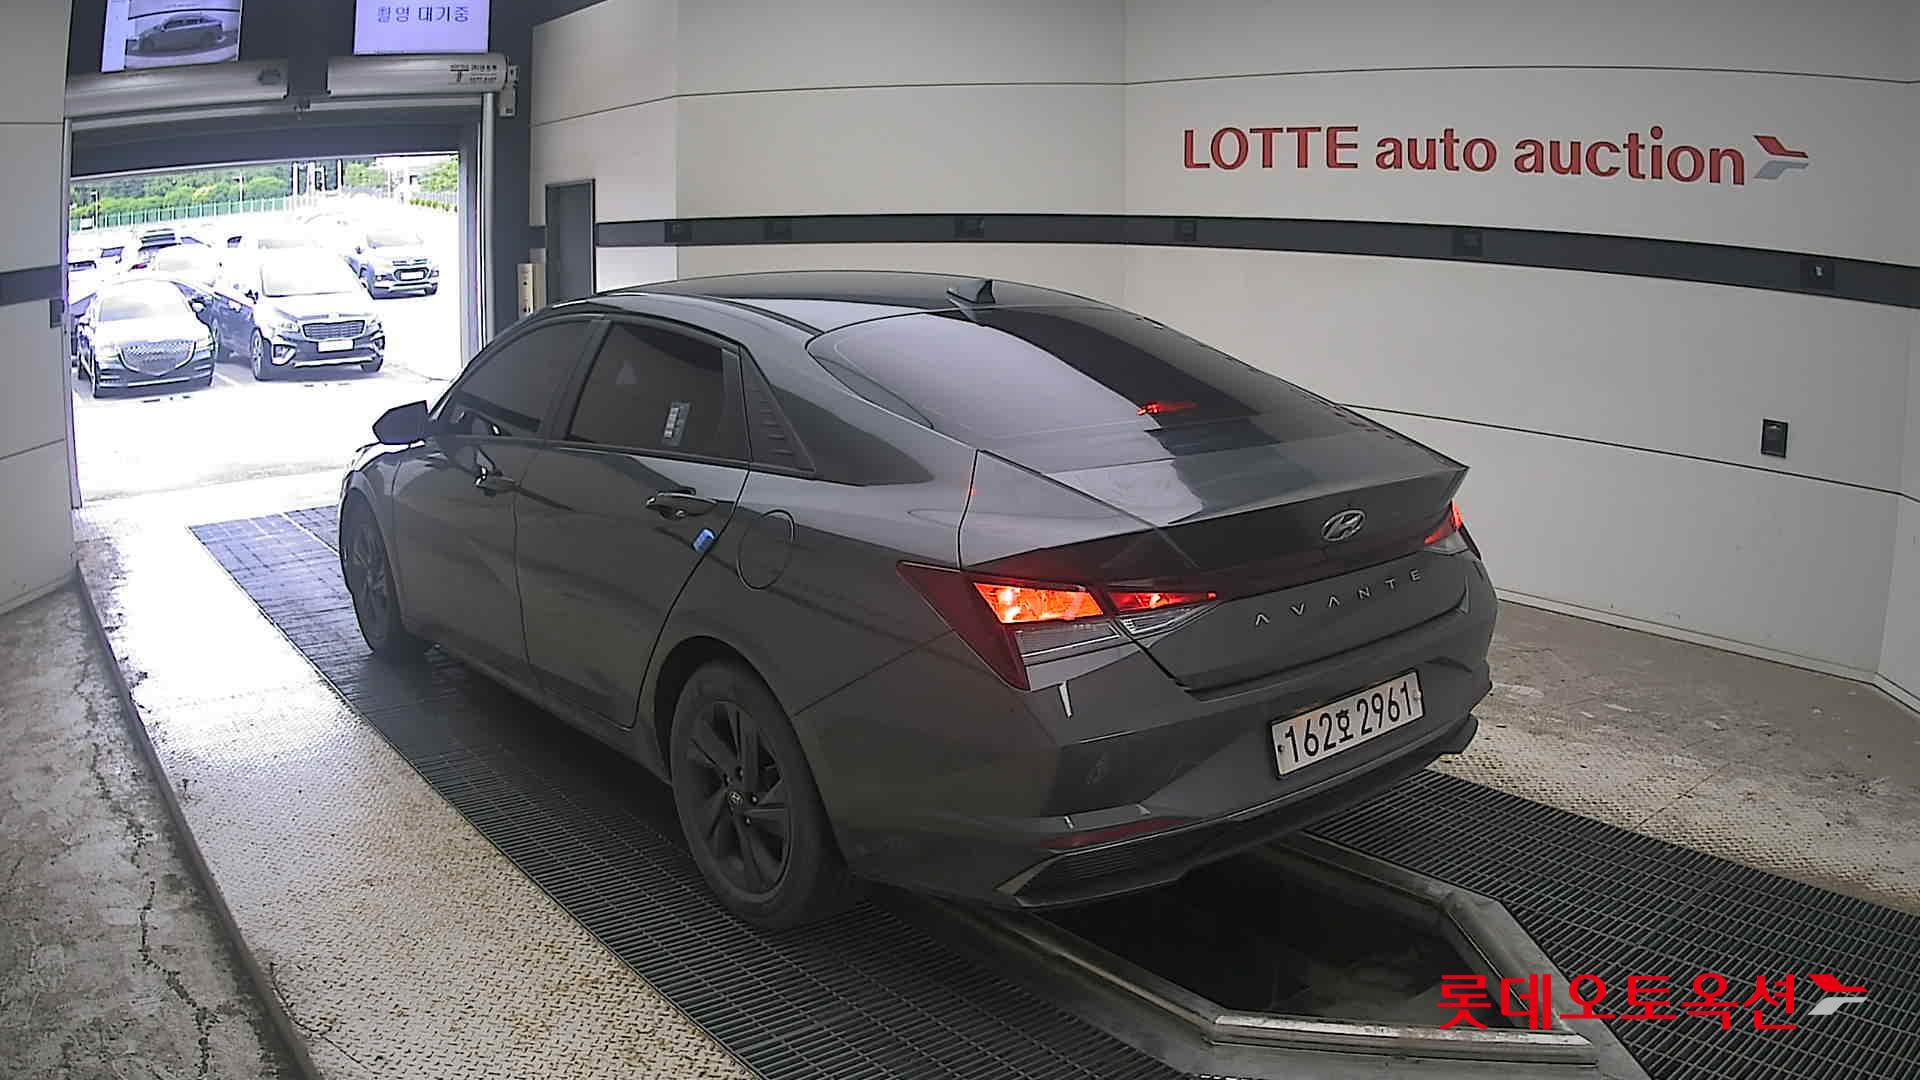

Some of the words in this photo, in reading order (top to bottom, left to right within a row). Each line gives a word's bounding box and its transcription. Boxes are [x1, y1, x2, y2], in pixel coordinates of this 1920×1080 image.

[418, 6, 469, 23] 대기중
[1183, 125, 1359, 170] LOTTE
[1375, 127, 1498, 172] auto
[1513, 126, 1745, 186] auction
[1254, 568, 1423, 628] AVANTE
[1284, 709, 1354, 763] 162호
[1356, 681, 1413, 737] 2961
